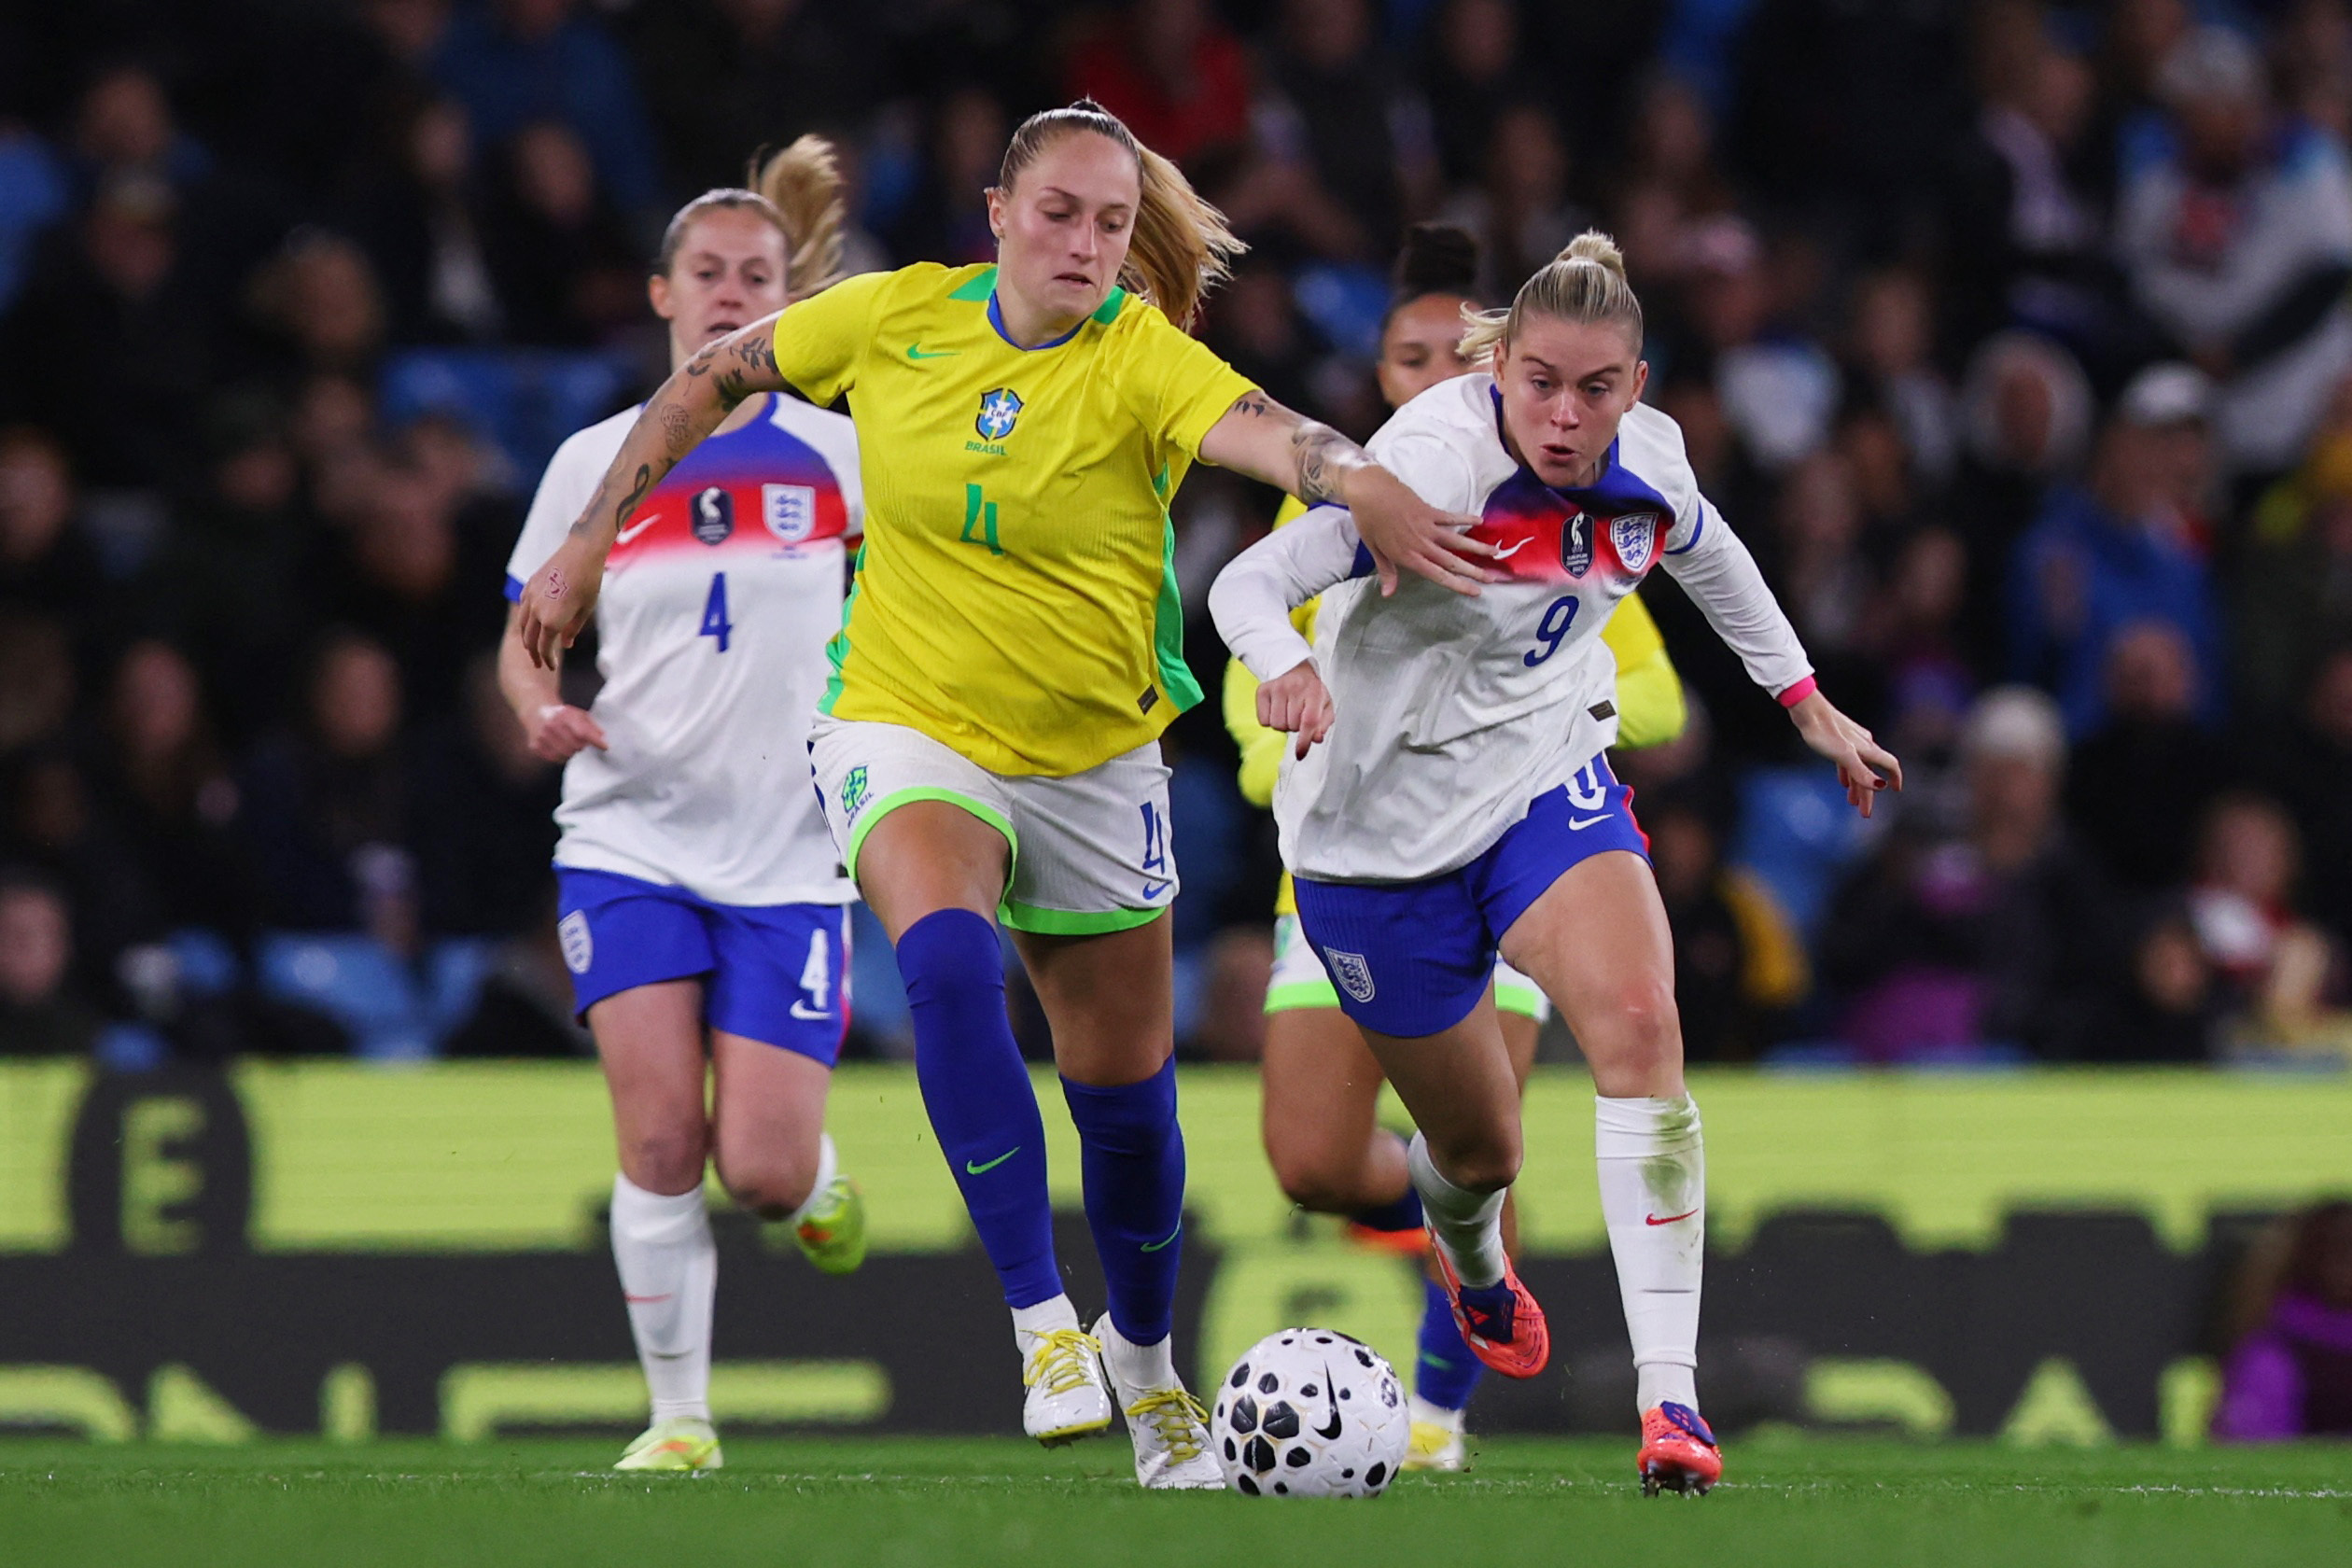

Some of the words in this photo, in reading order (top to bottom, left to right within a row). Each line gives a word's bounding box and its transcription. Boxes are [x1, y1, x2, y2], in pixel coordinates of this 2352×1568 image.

[965, 441, 1006, 455] BRASIL
[959, 483, 1003, 555] 4
[698, 571, 733, 653] 4
[1523, 595, 1580, 667] 9
[847, 791, 875, 829] BRASIL
[1140, 801, 1166, 875] 4
[799, 928, 831, 1010] 4
